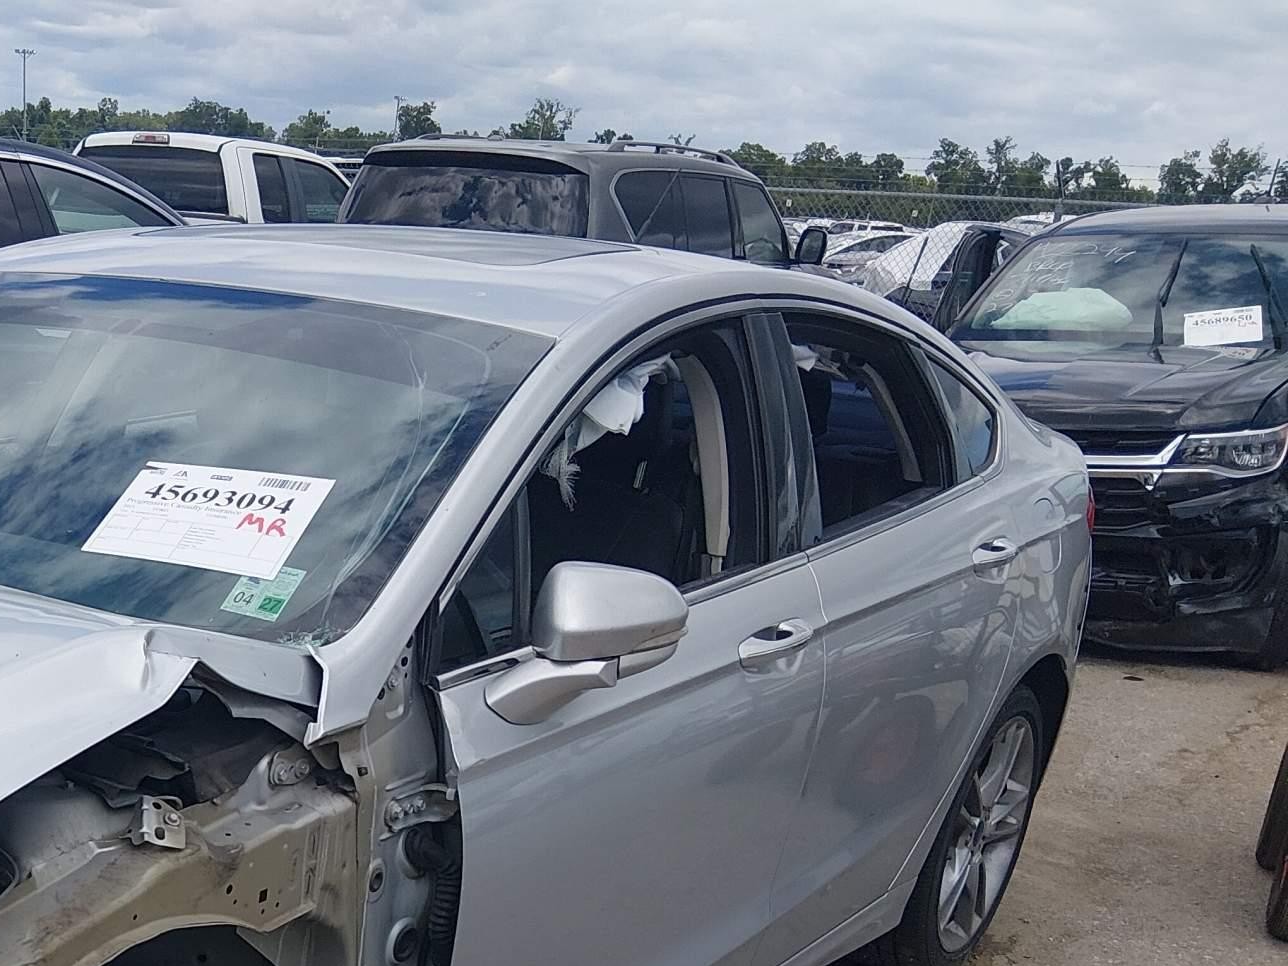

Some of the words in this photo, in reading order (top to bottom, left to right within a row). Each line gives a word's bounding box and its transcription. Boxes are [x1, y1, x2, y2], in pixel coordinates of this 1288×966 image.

[145, 482, 295, 515] 45693094
[235, 512, 287, 538] MR
[233, 591, 254, 606] 04
[258, 597, 281, 612] 27
